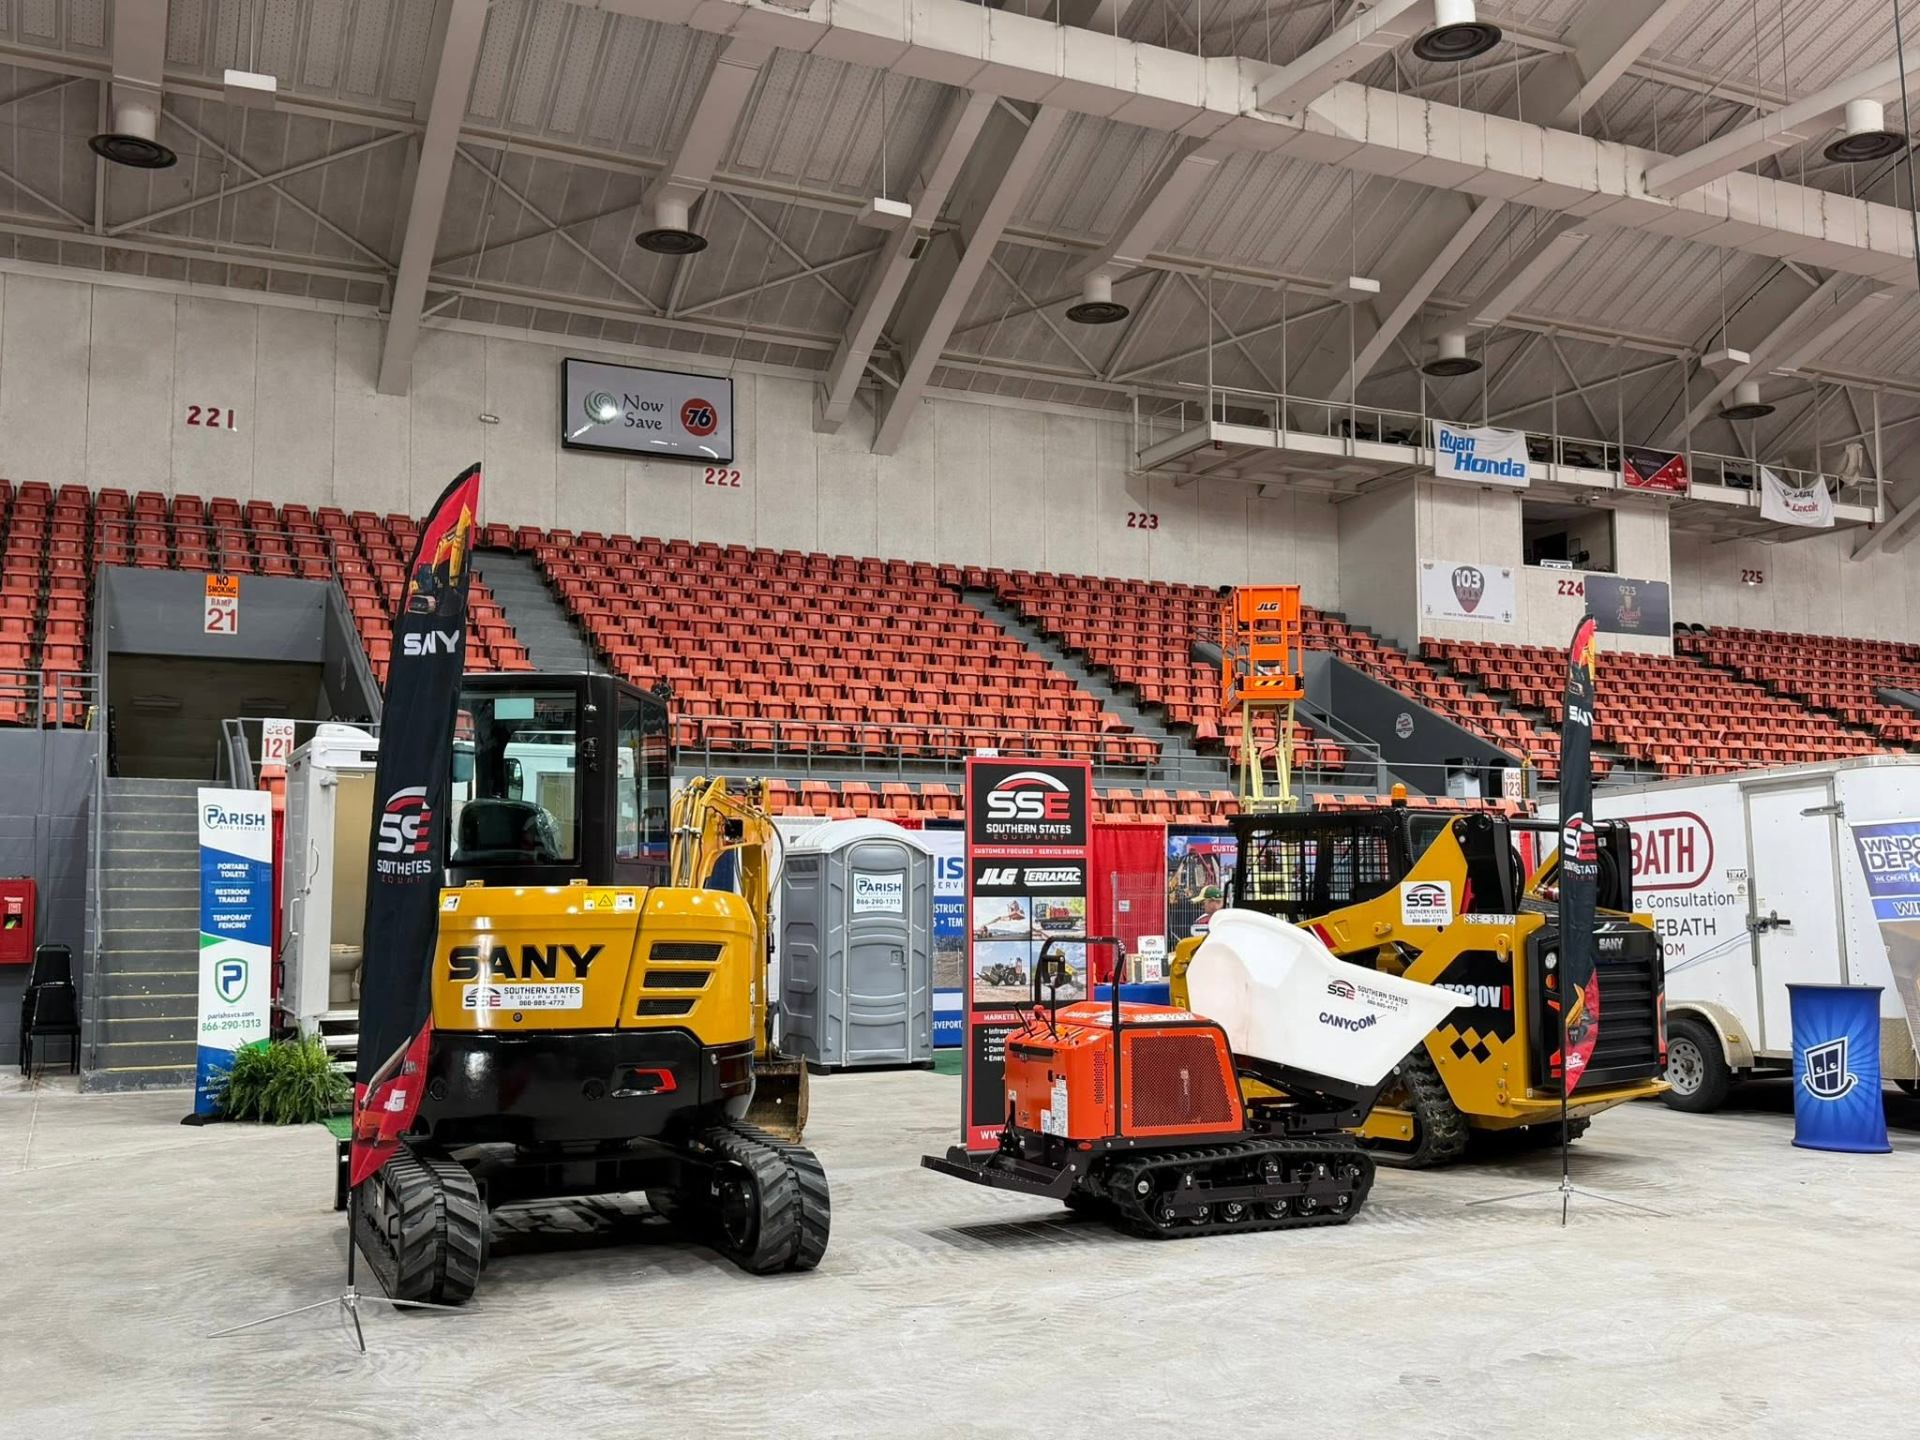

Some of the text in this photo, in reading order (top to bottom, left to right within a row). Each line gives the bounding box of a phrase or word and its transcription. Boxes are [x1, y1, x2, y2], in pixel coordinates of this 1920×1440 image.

[622, 393, 664, 413] Now
[187, 405, 234, 429] 221
[624, 412, 663, 430] Save
[686, 408, 712, 427] 76
[1439, 429, 1476, 454] Ryan
[1454, 453, 1526, 478] Honda
[705, 468, 741, 487] 222
[1127, 512, 1159, 529] 223
[216, 575, 229, 586] NO
[1455, 569, 1481, 588] 103
[1742, 569, 1763, 584] 225
[208, 585, 236, 593] SMOKING
[1558, 580, 1584, 596] 224
[211, 598, 232, 607] RAMP
[1257, 602, 1278, 611] JLG
[207, 607, 236, 631] 21
[264, 737, 292, 758] 121
[1505, 772, 1521, 780] SEC
[1504, 781, 1521, 797] 123
[987, 790, 1070, 820] SSE
[207, 807, 265, 827] PARISH
[986, 823, 1072, 835] SOUTHERN STATES
[993, 833, 1065, 841] EQUIPMENT
[1631, 826, 1695, 877] BATH
[217, 862, 249, 870] PORTABLE
[221, 870, 246, 878] TOILETS
[976, 867, 1081, 886] JLG TERRAMAC
[215, 888, 250, 896] RESTROOM
[859, 880, 901, 892] PARISH
[218, 896, 247, 904] TRAILERS
[1406, 893, 1446, 907] SSE
[1647, 891, 1735, 908] Consultation
[213, 913, 252, 922] TEMPORARY
[218, 921, 246, 929] FENCING
[1464, 914, 1514, 924] SSE-3172
[1599, 937, 1624, 950] SANY
[449, 943, 605, 982] SANY
[503, 986, 548, 995] SOUTHERN
[549, 986, 581, 994] STATES
[1327, 984, 1408, 1005] SSE SOUTHERN STATES
[201, 1018, 262, 1032] 866-290-1313
[1319, 1012, 1377, 1032] CANYCOM
